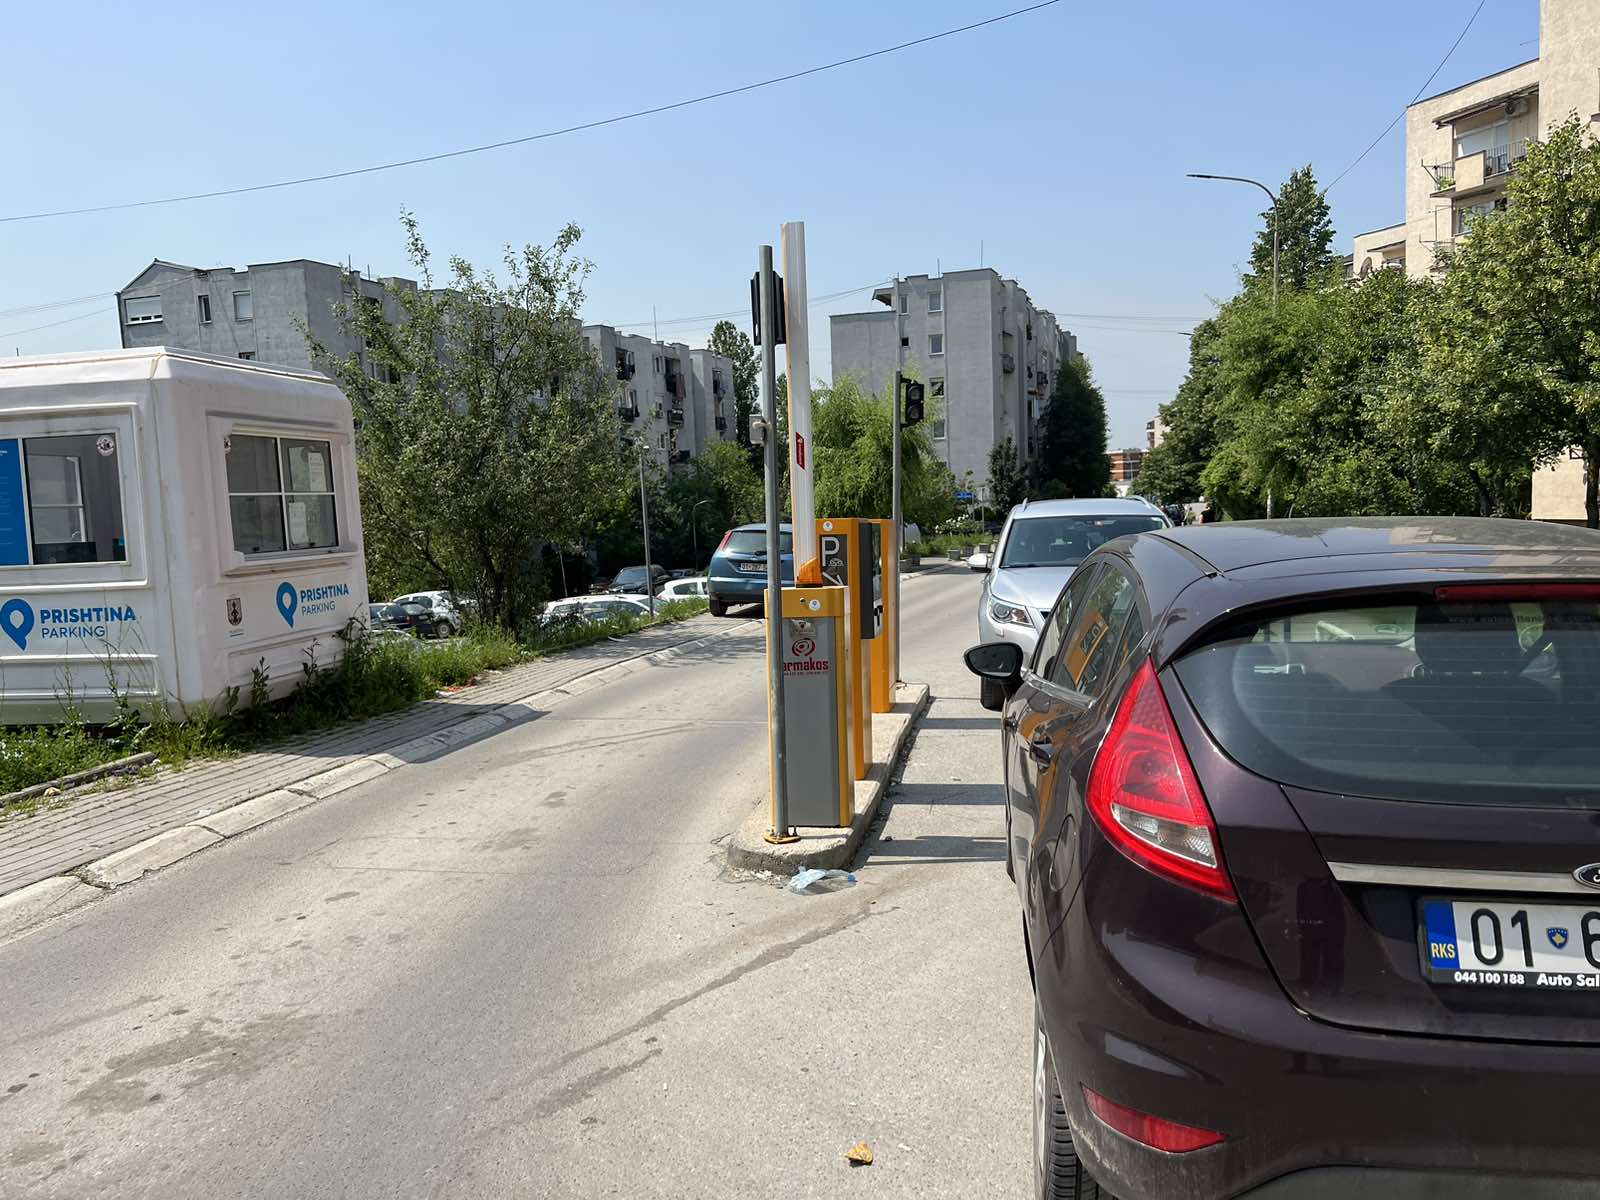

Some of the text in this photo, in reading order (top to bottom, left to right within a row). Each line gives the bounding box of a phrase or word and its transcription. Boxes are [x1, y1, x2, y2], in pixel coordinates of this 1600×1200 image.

[822, 536, 840, 566] P
[300, 583, 350, 603] PRISHTINA
[40, 606, 136, 624] PRISHTINA
[301, 601, 336, 616] PARKING
[41, 626, 106, 639] PARKING
[1470, 908, 1534, 968] 01
[1431, 942, 1456, 959] RKS
[1454, 971, 1600, 988] 044 100 188 Auto Sal
